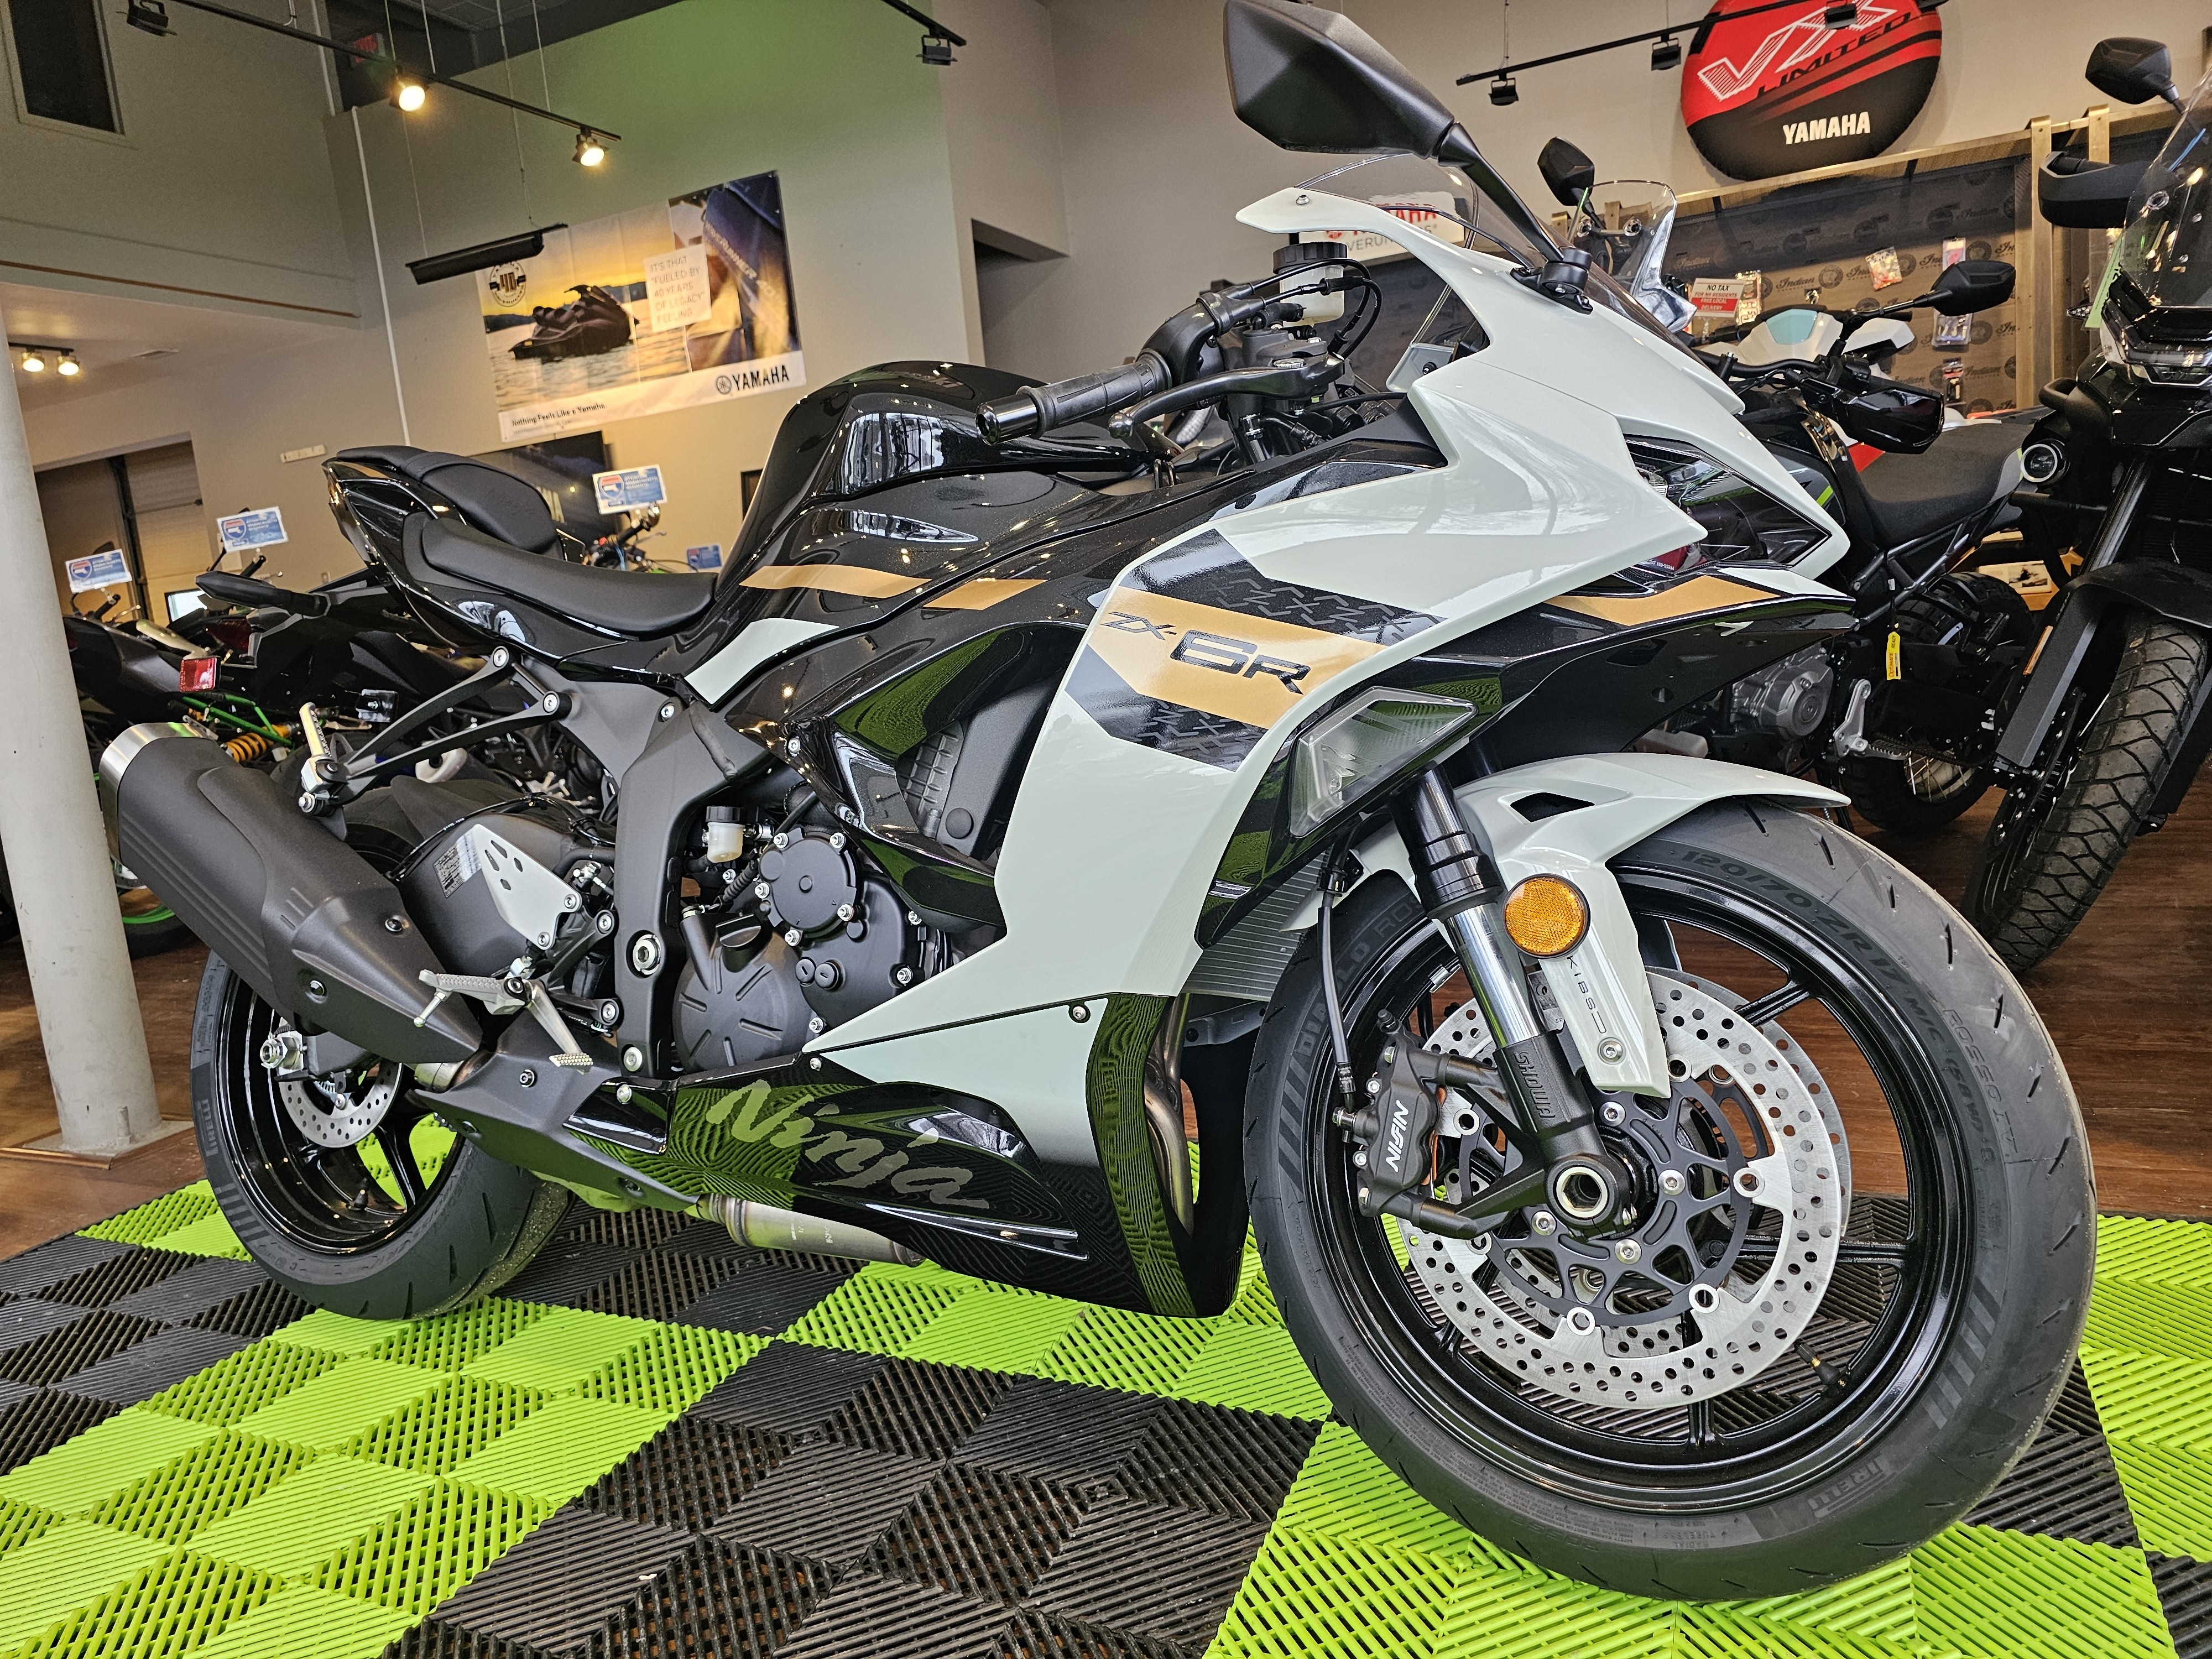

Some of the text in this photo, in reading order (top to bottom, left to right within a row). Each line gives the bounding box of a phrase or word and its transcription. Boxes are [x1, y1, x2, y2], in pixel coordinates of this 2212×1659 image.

[1757, 12, 1913, 100] LIMITED
[1782, 111, 1871, 145] YAMAHA
[650, 256, 687, 273] IT'S THAT
[655, 282, 694, 298] 40 YEARS
[690, 266, 701, 277] BY
[1776, 276, 1815, 289] Indian
[655, 300, 667, 312] OF
[657, 308, 693, 325] FEELING
[732, 364, 790, 391] YAMAHA
[512, 418, 537, 427] Nothing
[556, 409, 571, 418] Like
[1101, 612, 1311, 695] ZX-6R
[1680, 850, 1813, 910] 120/70
[1821, 914, 1872, 958] ZR
[1294, 941, 1371, 1056] DIALO
[1566, 955, 1597, 1011] KIBS
[1942, 1009, 2002, 1102] ROSSO
[1513, 1052, 1556, 1118] SHOWA
[197, 1099, 218, 1157] PIRELLI
[705, 1079, 990, 1209] Ninja
[1807, 1455, 1898, 1520] PIRELLI
